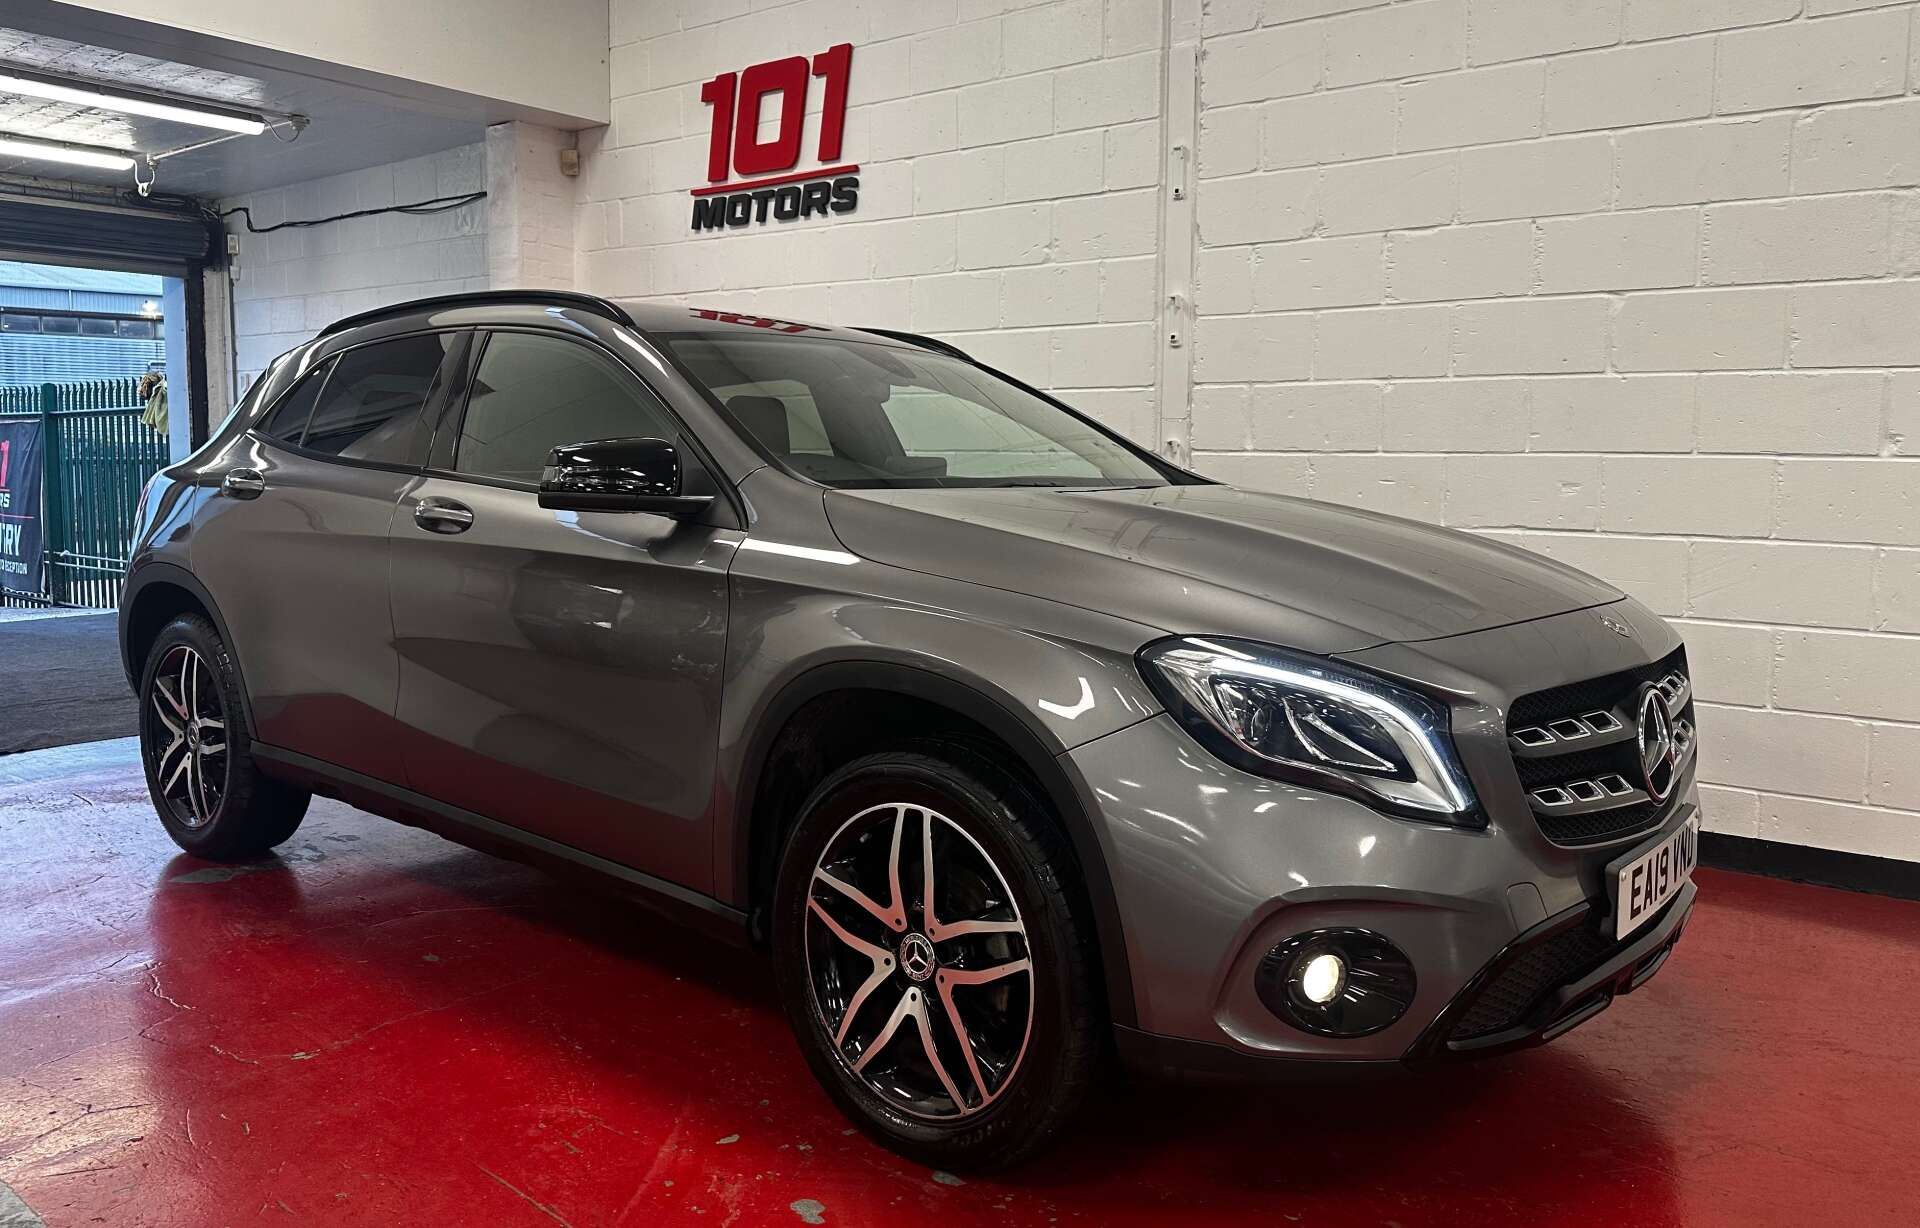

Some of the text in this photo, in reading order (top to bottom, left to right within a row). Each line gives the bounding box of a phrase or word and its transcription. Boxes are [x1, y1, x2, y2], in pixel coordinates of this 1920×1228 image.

[701, 43, 853, 182] 101
[691, 176, 859, 230] MOTORS
[1630, 846, 1669, 920] EA19
